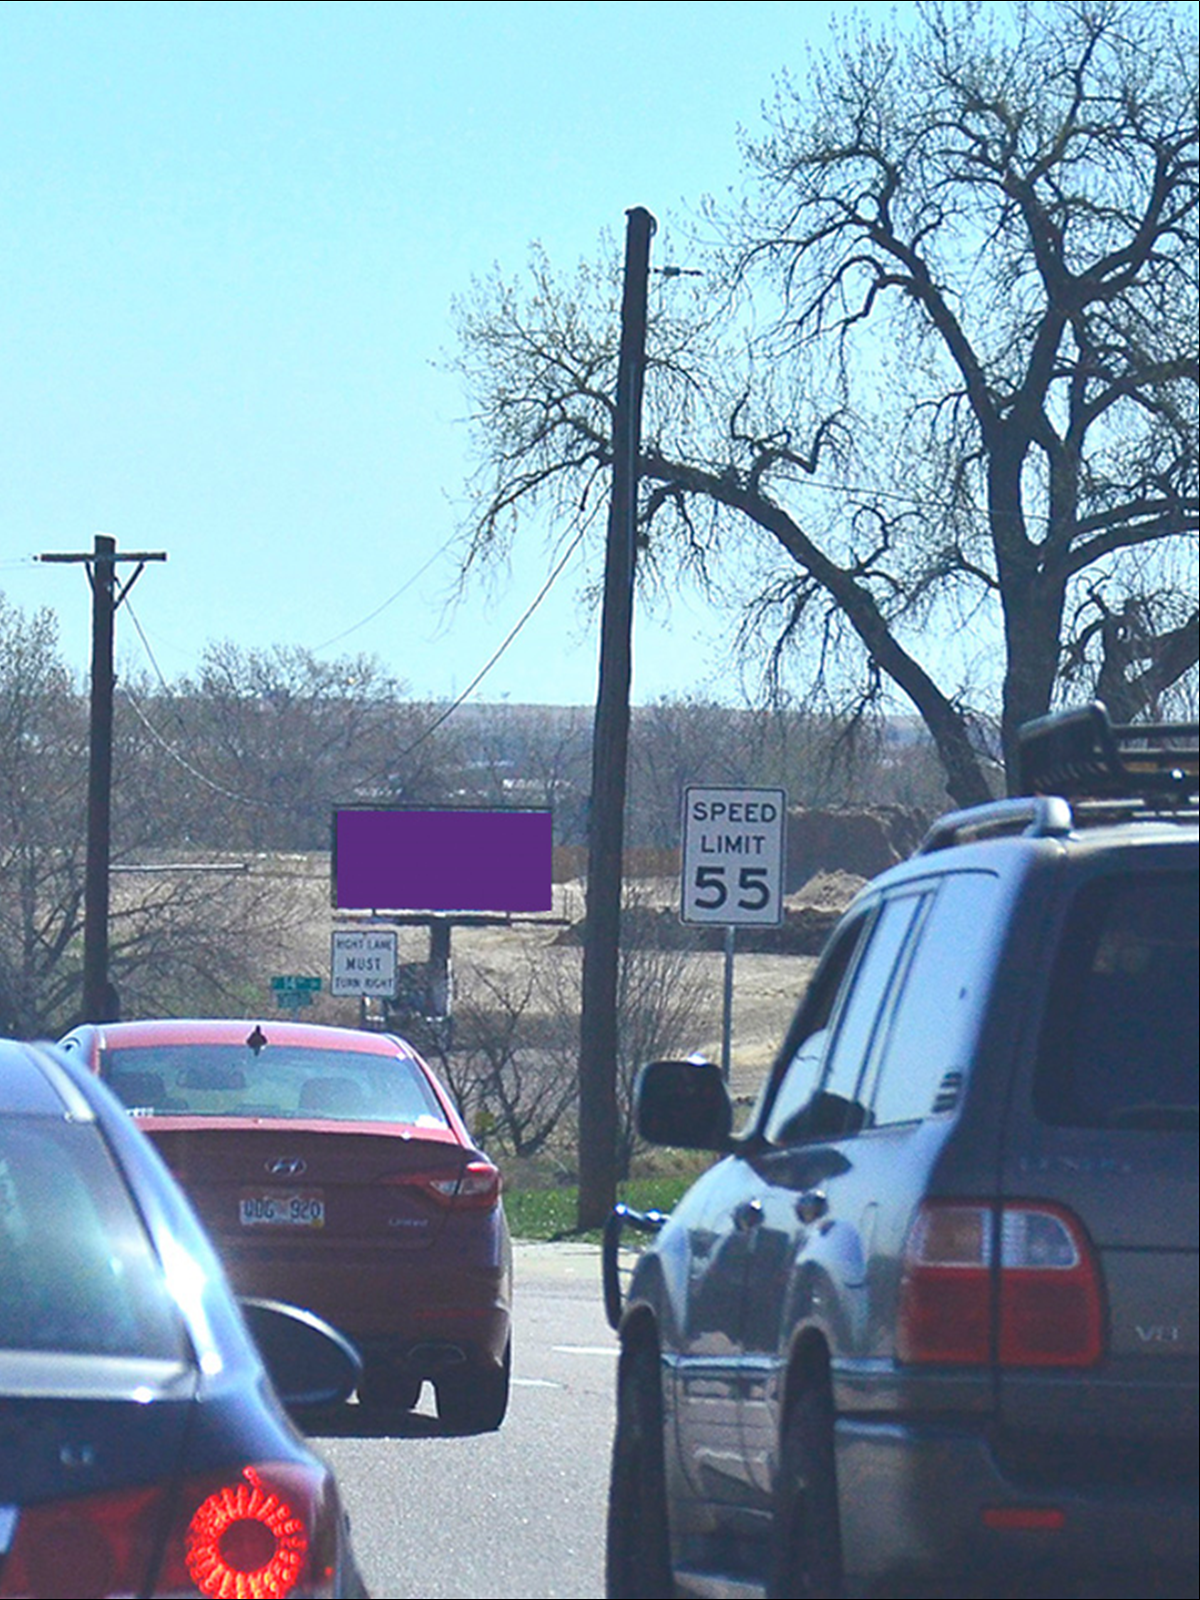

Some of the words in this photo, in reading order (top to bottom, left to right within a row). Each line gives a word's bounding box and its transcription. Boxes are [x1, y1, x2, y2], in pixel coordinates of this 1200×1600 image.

[693, 802, 777, 823] SPEED
[701, 835, 766, 854] LIMIT
[694, 866, 771, 911] 55
[345, 957, 381, 971] MUST
[335, 977, 360, 988] TURN
[364, 978, 393, 989] RIGHT
[290, 1199, 321, 1219] 920
